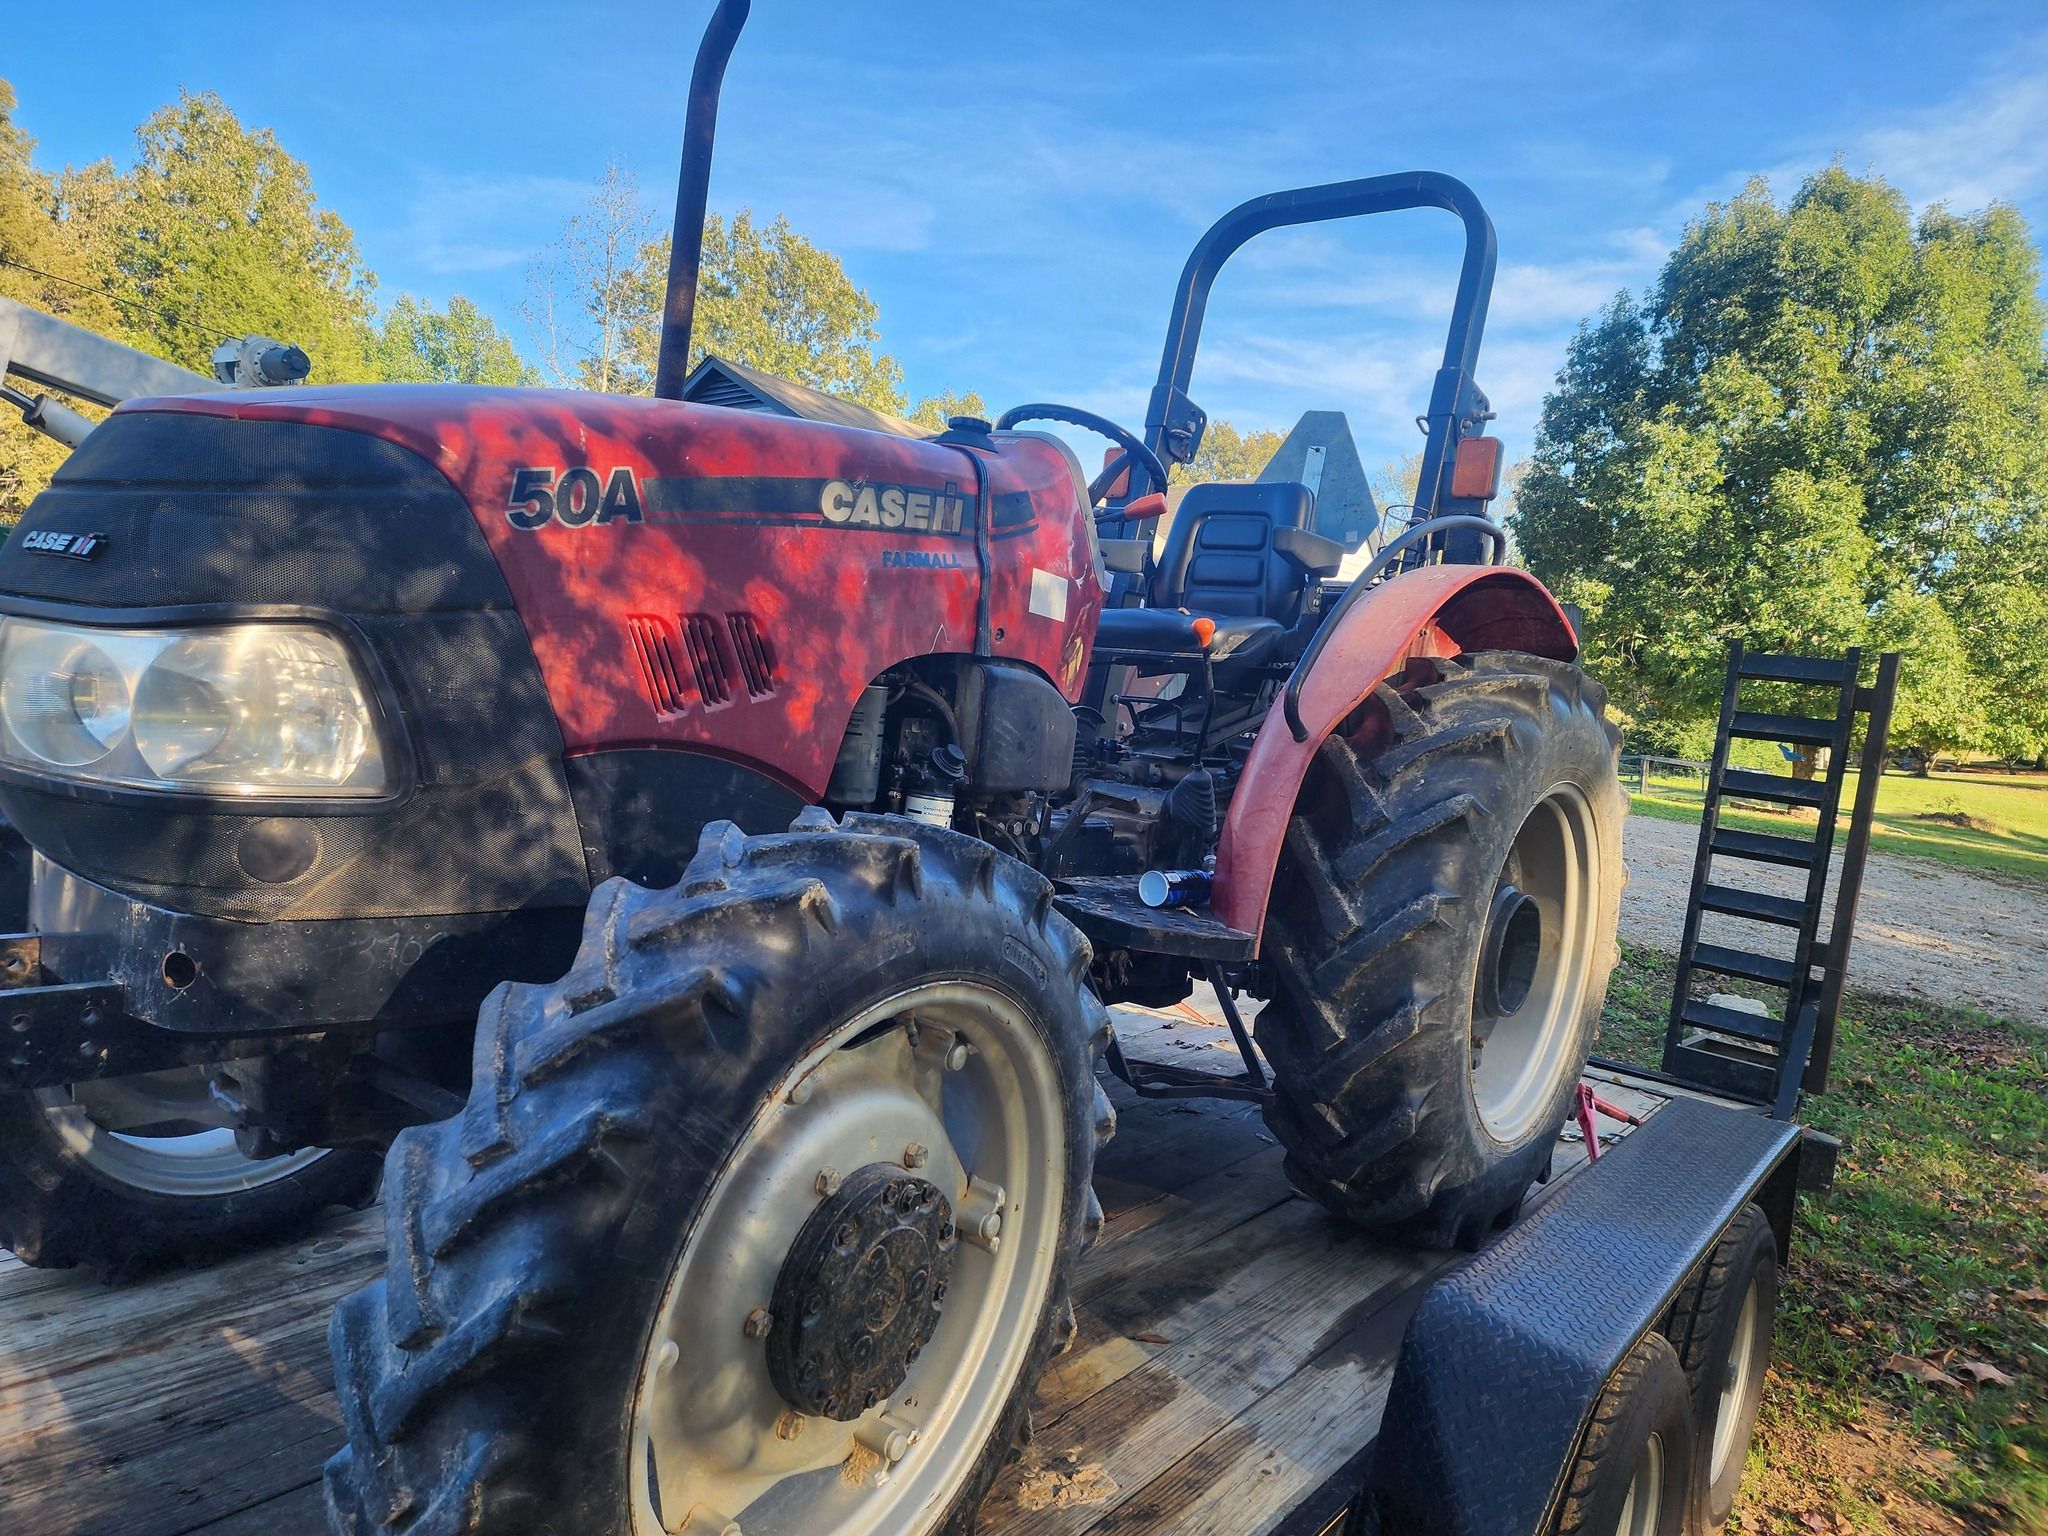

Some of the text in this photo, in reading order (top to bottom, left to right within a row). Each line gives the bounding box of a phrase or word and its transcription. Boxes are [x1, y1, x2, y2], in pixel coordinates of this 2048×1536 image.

[504, 466, 645, 531] 50A
[821, 480, 930, 530] CASE
[22, 530, 74, 551] CASE
[882, 550, 962, 568] FARMALL
